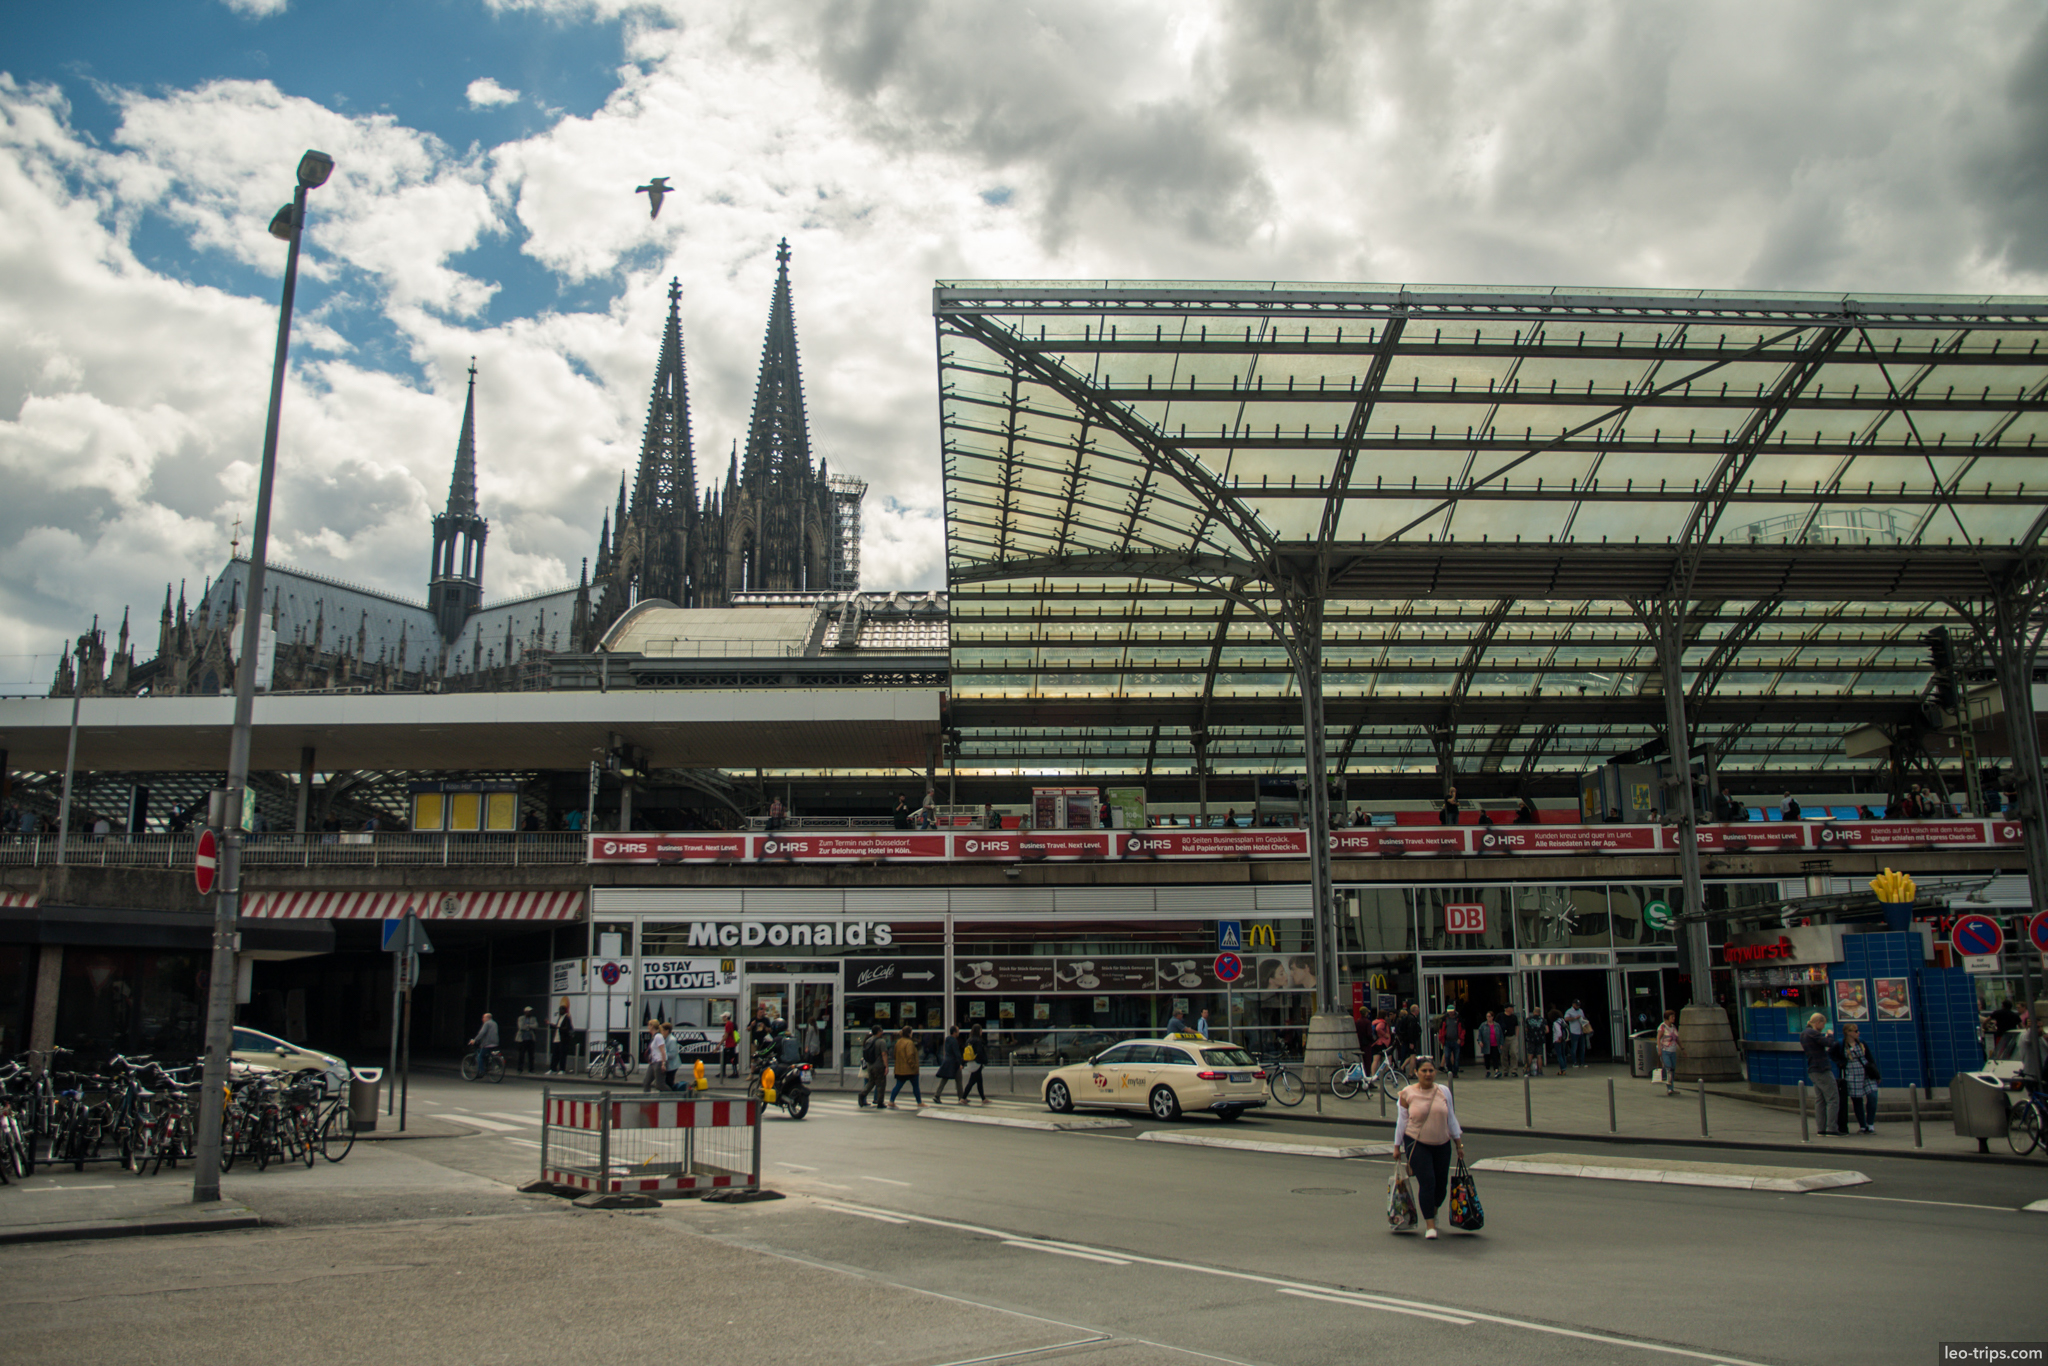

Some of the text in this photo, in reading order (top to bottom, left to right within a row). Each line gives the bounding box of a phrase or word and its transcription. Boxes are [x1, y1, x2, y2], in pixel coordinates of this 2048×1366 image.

[1213, 836, 1254, 844] Businessplan
[1265, 835, 1290, 844] Gepäck.
[1698, 833, 1713, 842] RS
[1836, 830, 1862, 840] HRS
[1143, 840, 1172, 849] HRS
[1341, 838, 1369, 847] HRS
[1498, 836, 1525, 845] HRS
[619, 844, 648, 853] HRS
[780, 842, 808, 852] HRS
[981, 841, 1009, 851] HRS
[1450, 908, 1481, 928] DB
[1649, 904, 1668, 927] S
[688, 922, 892, 946] McDonald's
[1724, 936, 1792, 964] Currywurst
[619, 964, 631, 975] O,
[645, 961, 692, 972] TO STAY
[645, 975, 668, 990] TO
[1128, 1077, 1146, 1086] mytaxi
